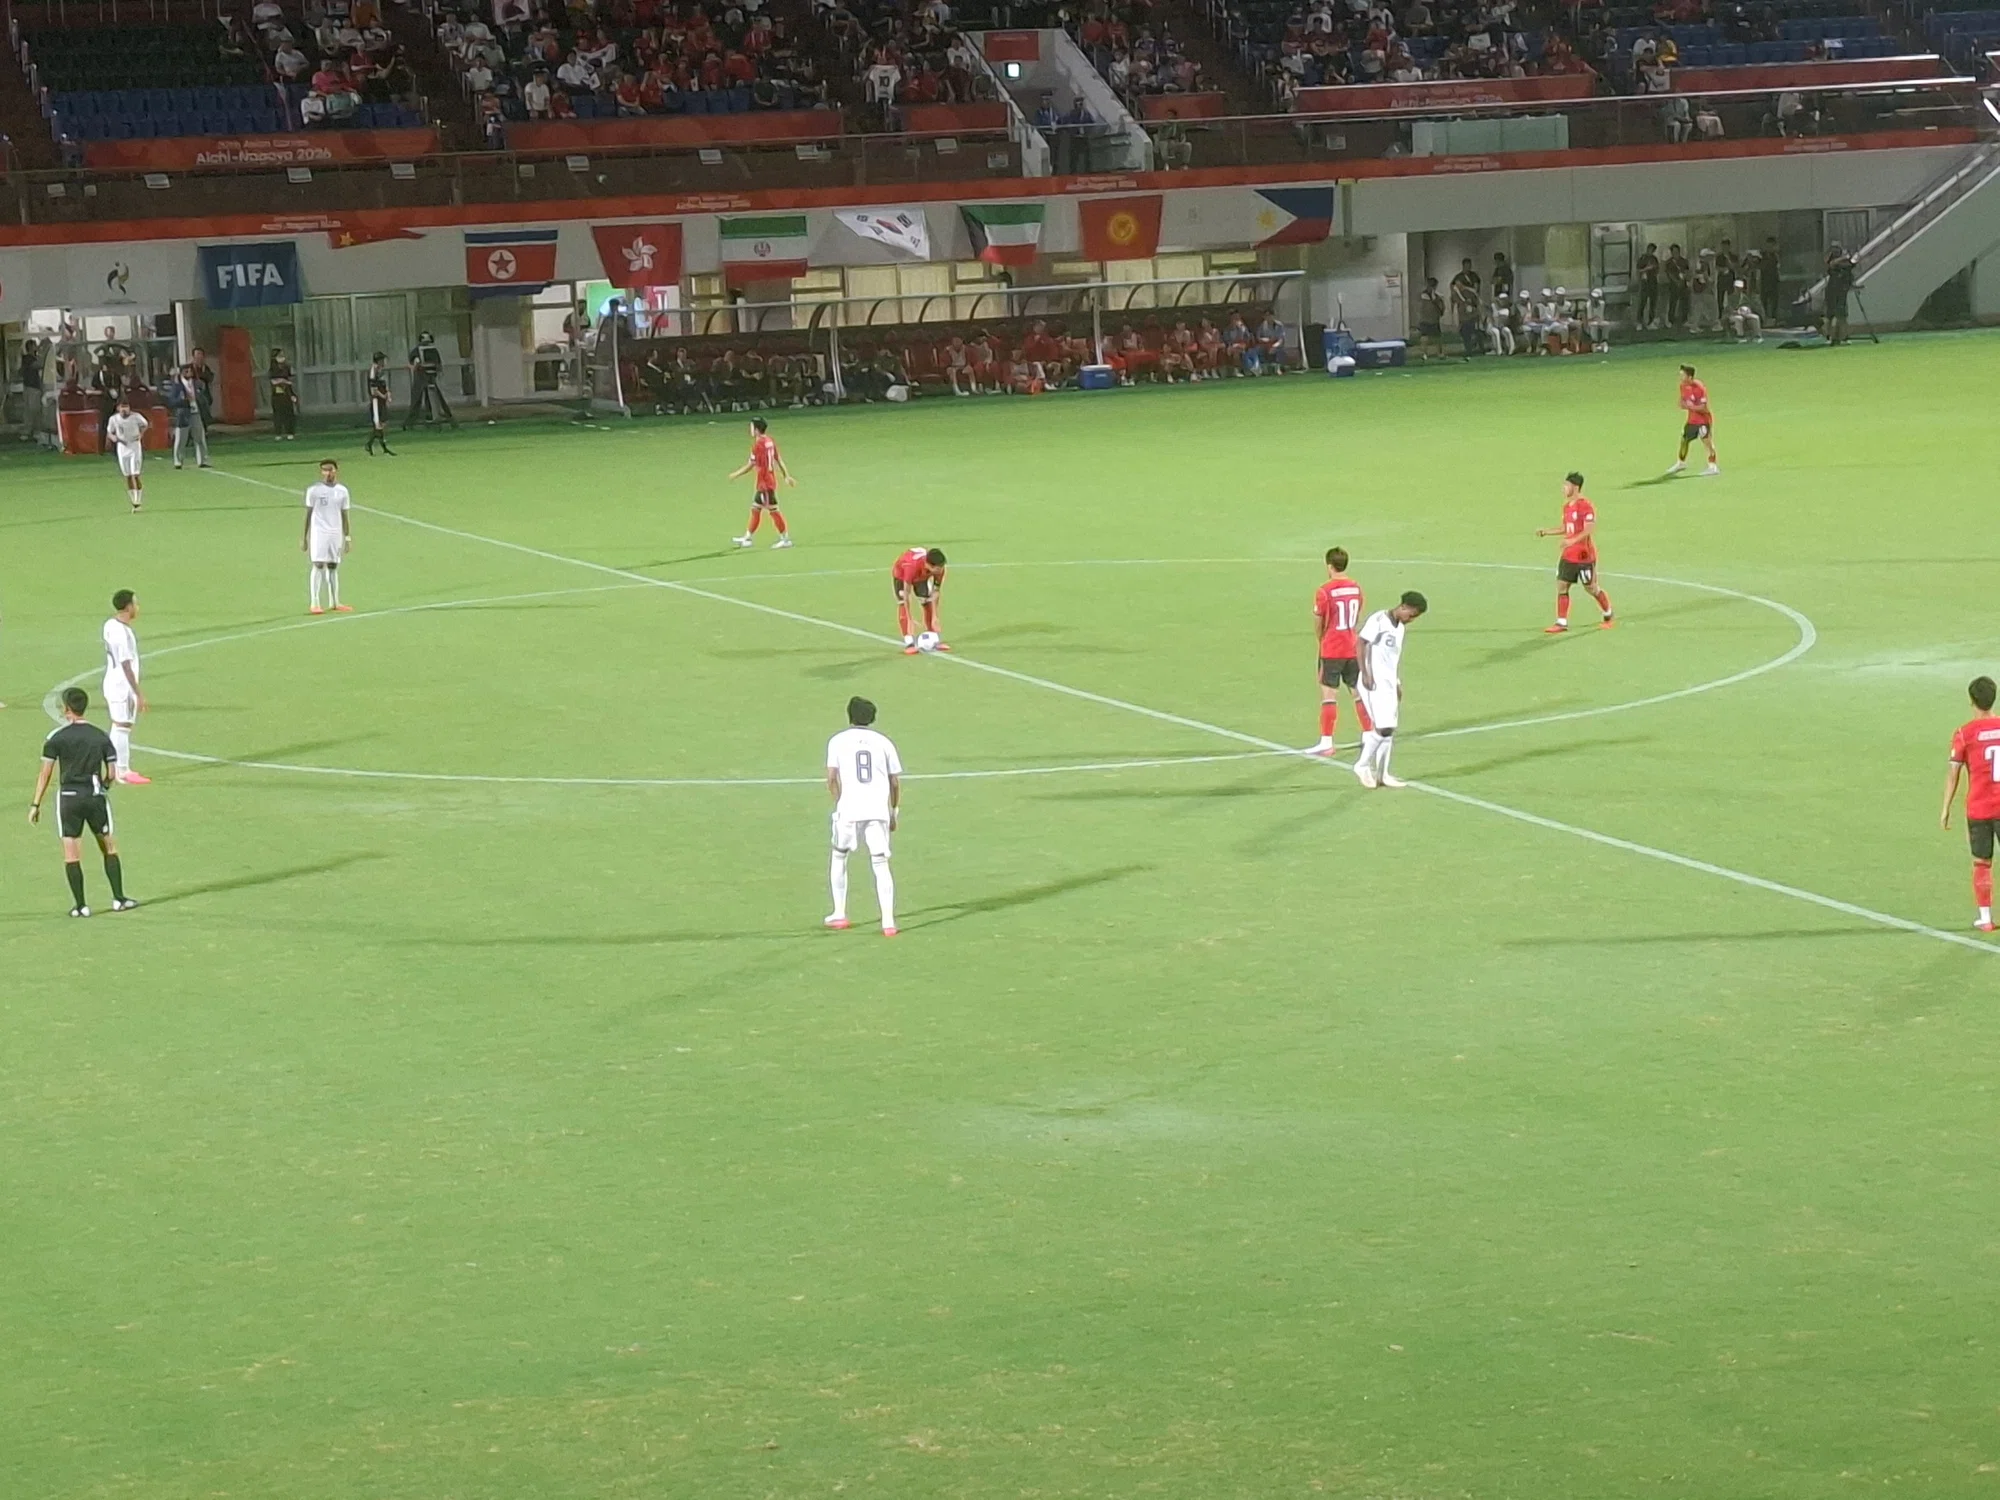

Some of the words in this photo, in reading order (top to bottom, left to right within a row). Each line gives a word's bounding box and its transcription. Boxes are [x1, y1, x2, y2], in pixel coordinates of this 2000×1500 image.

[296, 147, 332, 161] 2026
[217, 263, 284, 289] FIFA
[1335, 599, 1360, 631] 10
[855, 750, 873, 784] 8
